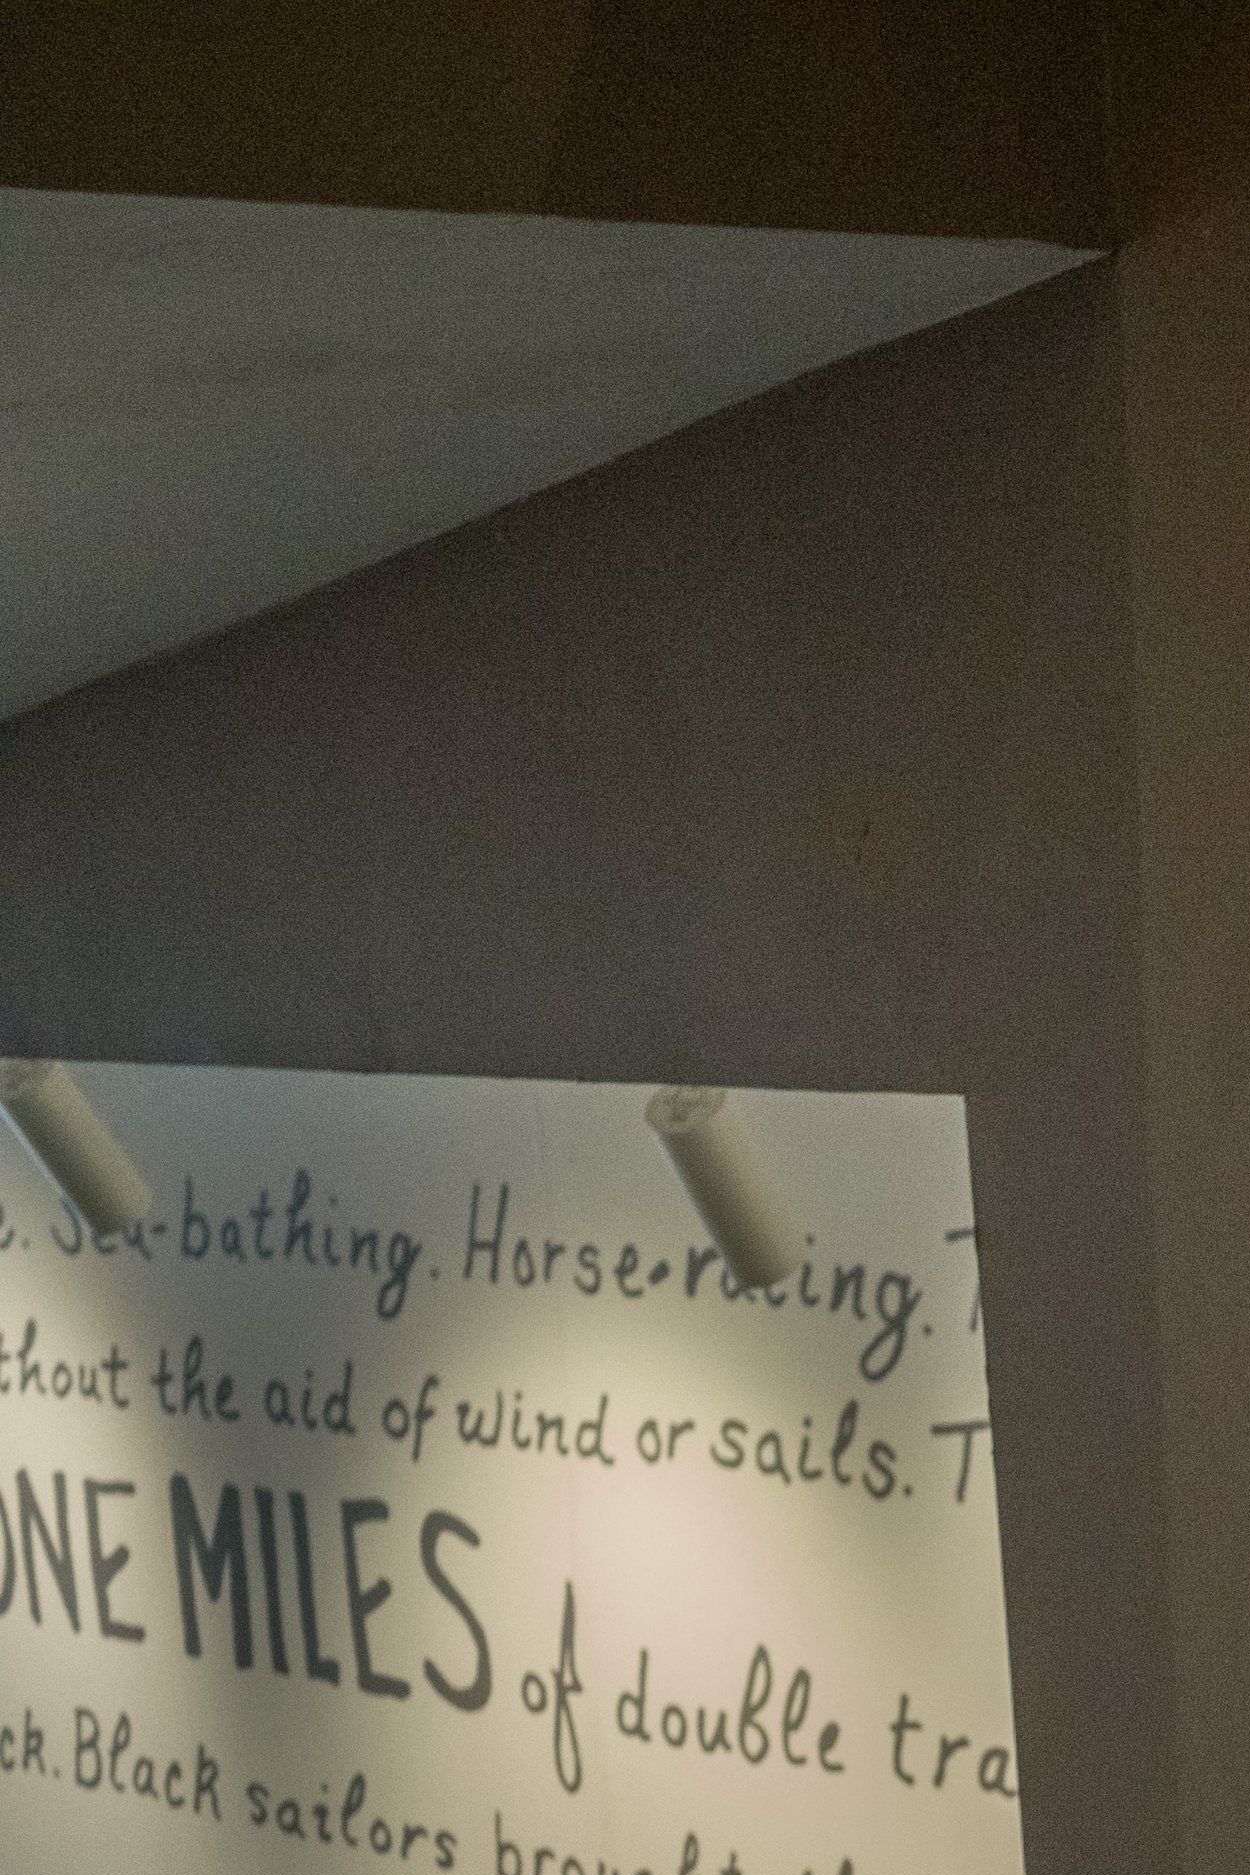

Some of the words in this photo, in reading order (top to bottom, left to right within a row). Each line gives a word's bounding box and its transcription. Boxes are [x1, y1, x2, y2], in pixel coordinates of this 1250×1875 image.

[150, 1336, 241, 1421] the
[264, 1360, 356, 1436] aid
[382, 1375, 441, 1463] of
[457, 1391, 615, 1467] wind
[636, 1418, 695, 1464] or
[709, 1400, 914, 1500] sails.
[0, 1467, 147, 1643] NE
[169, 1472, 493, 1713] MILES
[521, 1578, 584, 1795] of
[616, 1646, 845, 1774] double
[889, 1692, 1018, 1799] tra
[74, 1705, 223, 1822] Black
[246, 1771, 458, 1870] sailors
